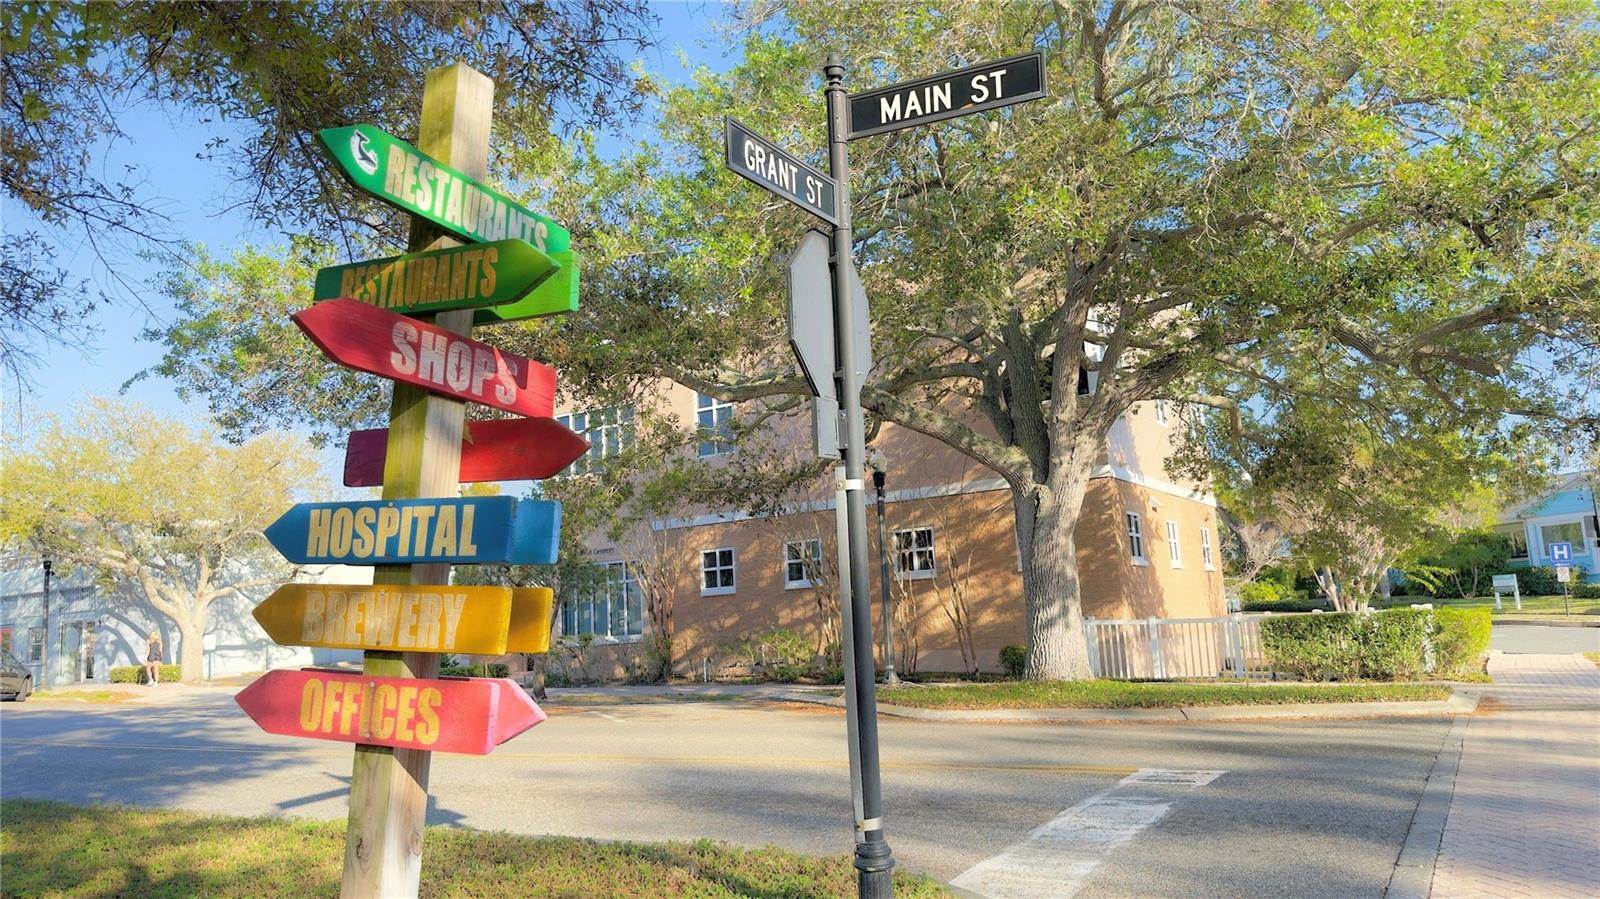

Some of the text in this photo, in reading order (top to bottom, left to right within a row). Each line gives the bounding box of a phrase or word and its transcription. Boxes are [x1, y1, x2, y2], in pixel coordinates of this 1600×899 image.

[880, 69, 1007, 124] MAIN ST
[384, 143, 548, 253] RESTAURANTS
[744, 139, 824, 209] GRANT ST
[340, 247, 499, 308] RESTAURANTS
[390, 320, 517, 405] SHOPS
[306, 503, 477, 559] HOSPITAL
[1553, 544, 1569, 560] H
[302, 591, 468, 649] BREWERY
[300, 678, 442, 745] OFFICES
